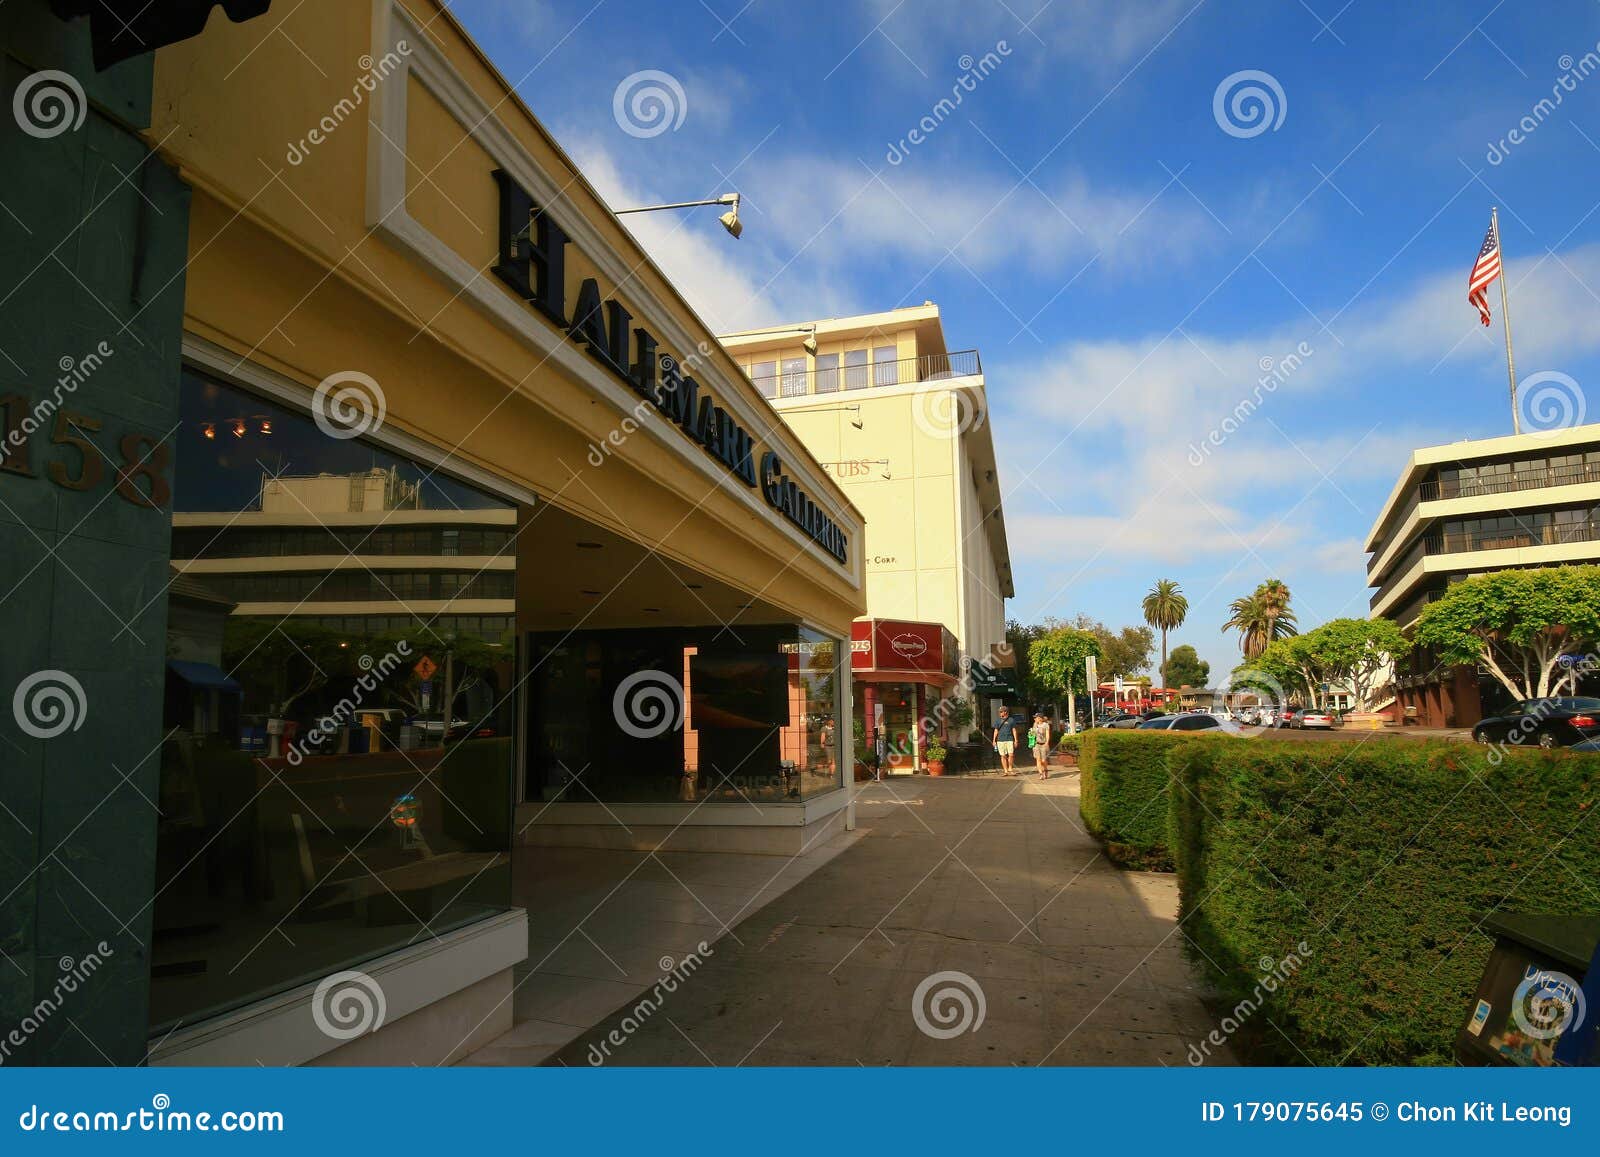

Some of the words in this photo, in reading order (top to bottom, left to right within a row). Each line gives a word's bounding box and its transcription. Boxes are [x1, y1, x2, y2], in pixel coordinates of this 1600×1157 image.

[490, 168, 758, 488] HALLMARK
[760, 450, 848, 565] GALLERIES
[0, 393, 171, 508] 158
[836, 458, 870, 478] UBS
